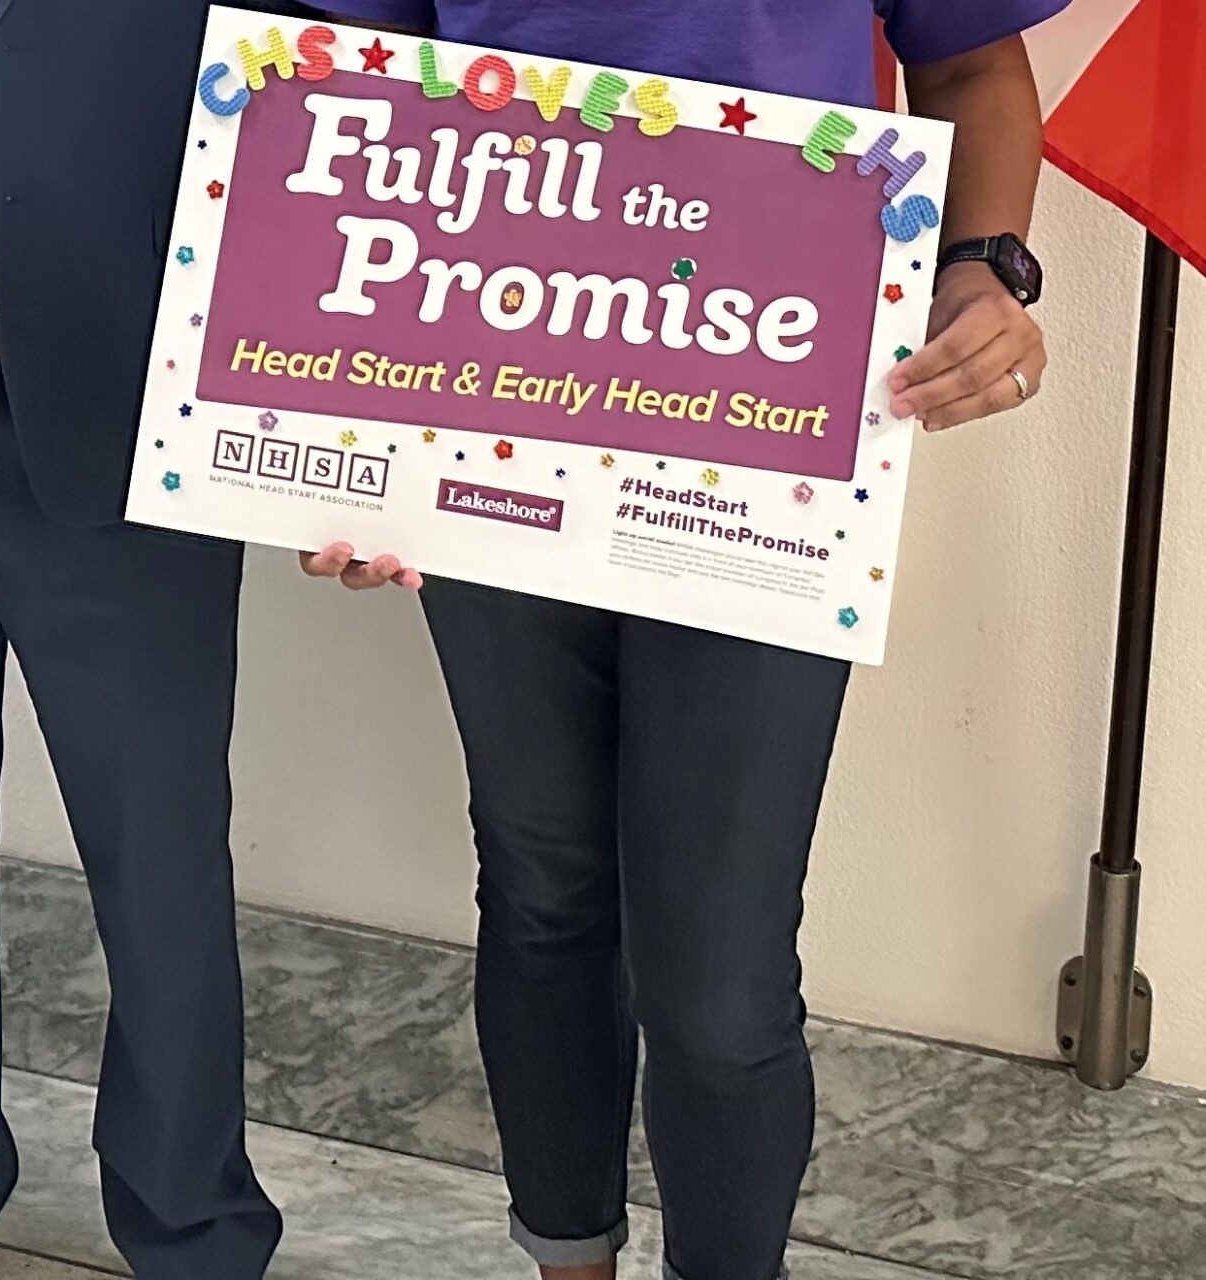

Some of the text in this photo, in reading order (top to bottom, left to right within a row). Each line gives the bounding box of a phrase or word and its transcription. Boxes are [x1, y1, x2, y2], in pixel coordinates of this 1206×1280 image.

[198, 25, 940, 244] CHS LOVES EHS
[284, 92, 710, 235] Fulfill the
[317, 214, 820, 363] Promise
[228, 337, 831, 439] Head Start & Early Head Start
[208, 473, 385, 513] NATIONAL HEAD START ASSOCIATION
[220, 438, 380, 489] NHSA
[619, 476, 750, 518] #HeadStart
[615, 501, 831, 562] #FulfillThePromise
